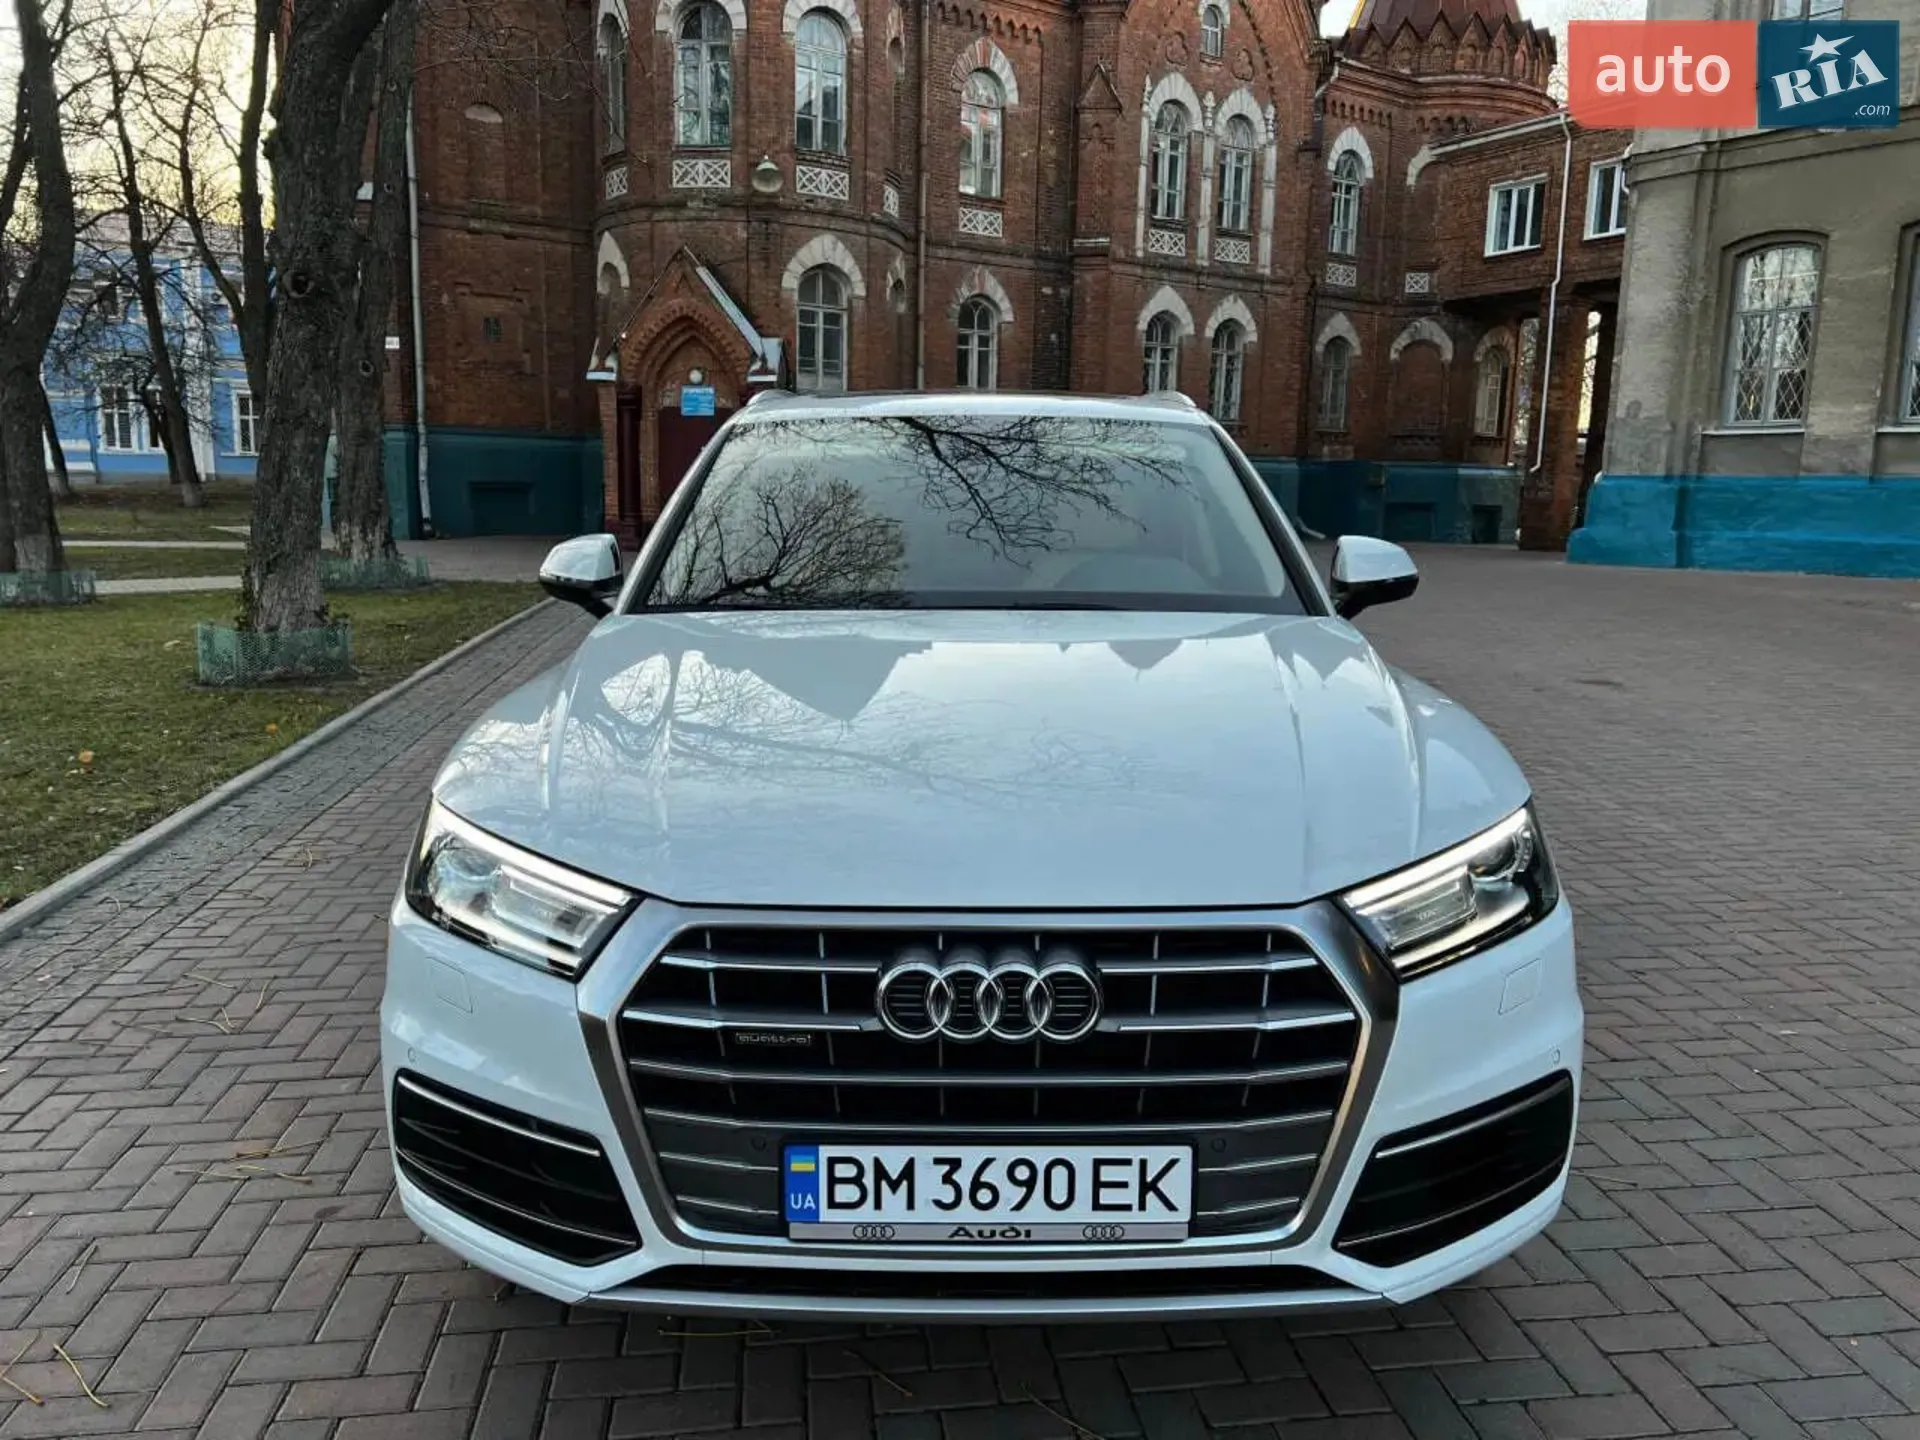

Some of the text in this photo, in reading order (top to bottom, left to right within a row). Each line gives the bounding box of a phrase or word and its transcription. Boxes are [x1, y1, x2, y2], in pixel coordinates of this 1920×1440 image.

[826, 1156, 1181, 1212] BM 3690 EK
[790, 1194, 816, 1210] UA
[948, 1227, 1032, 1239] Audi
